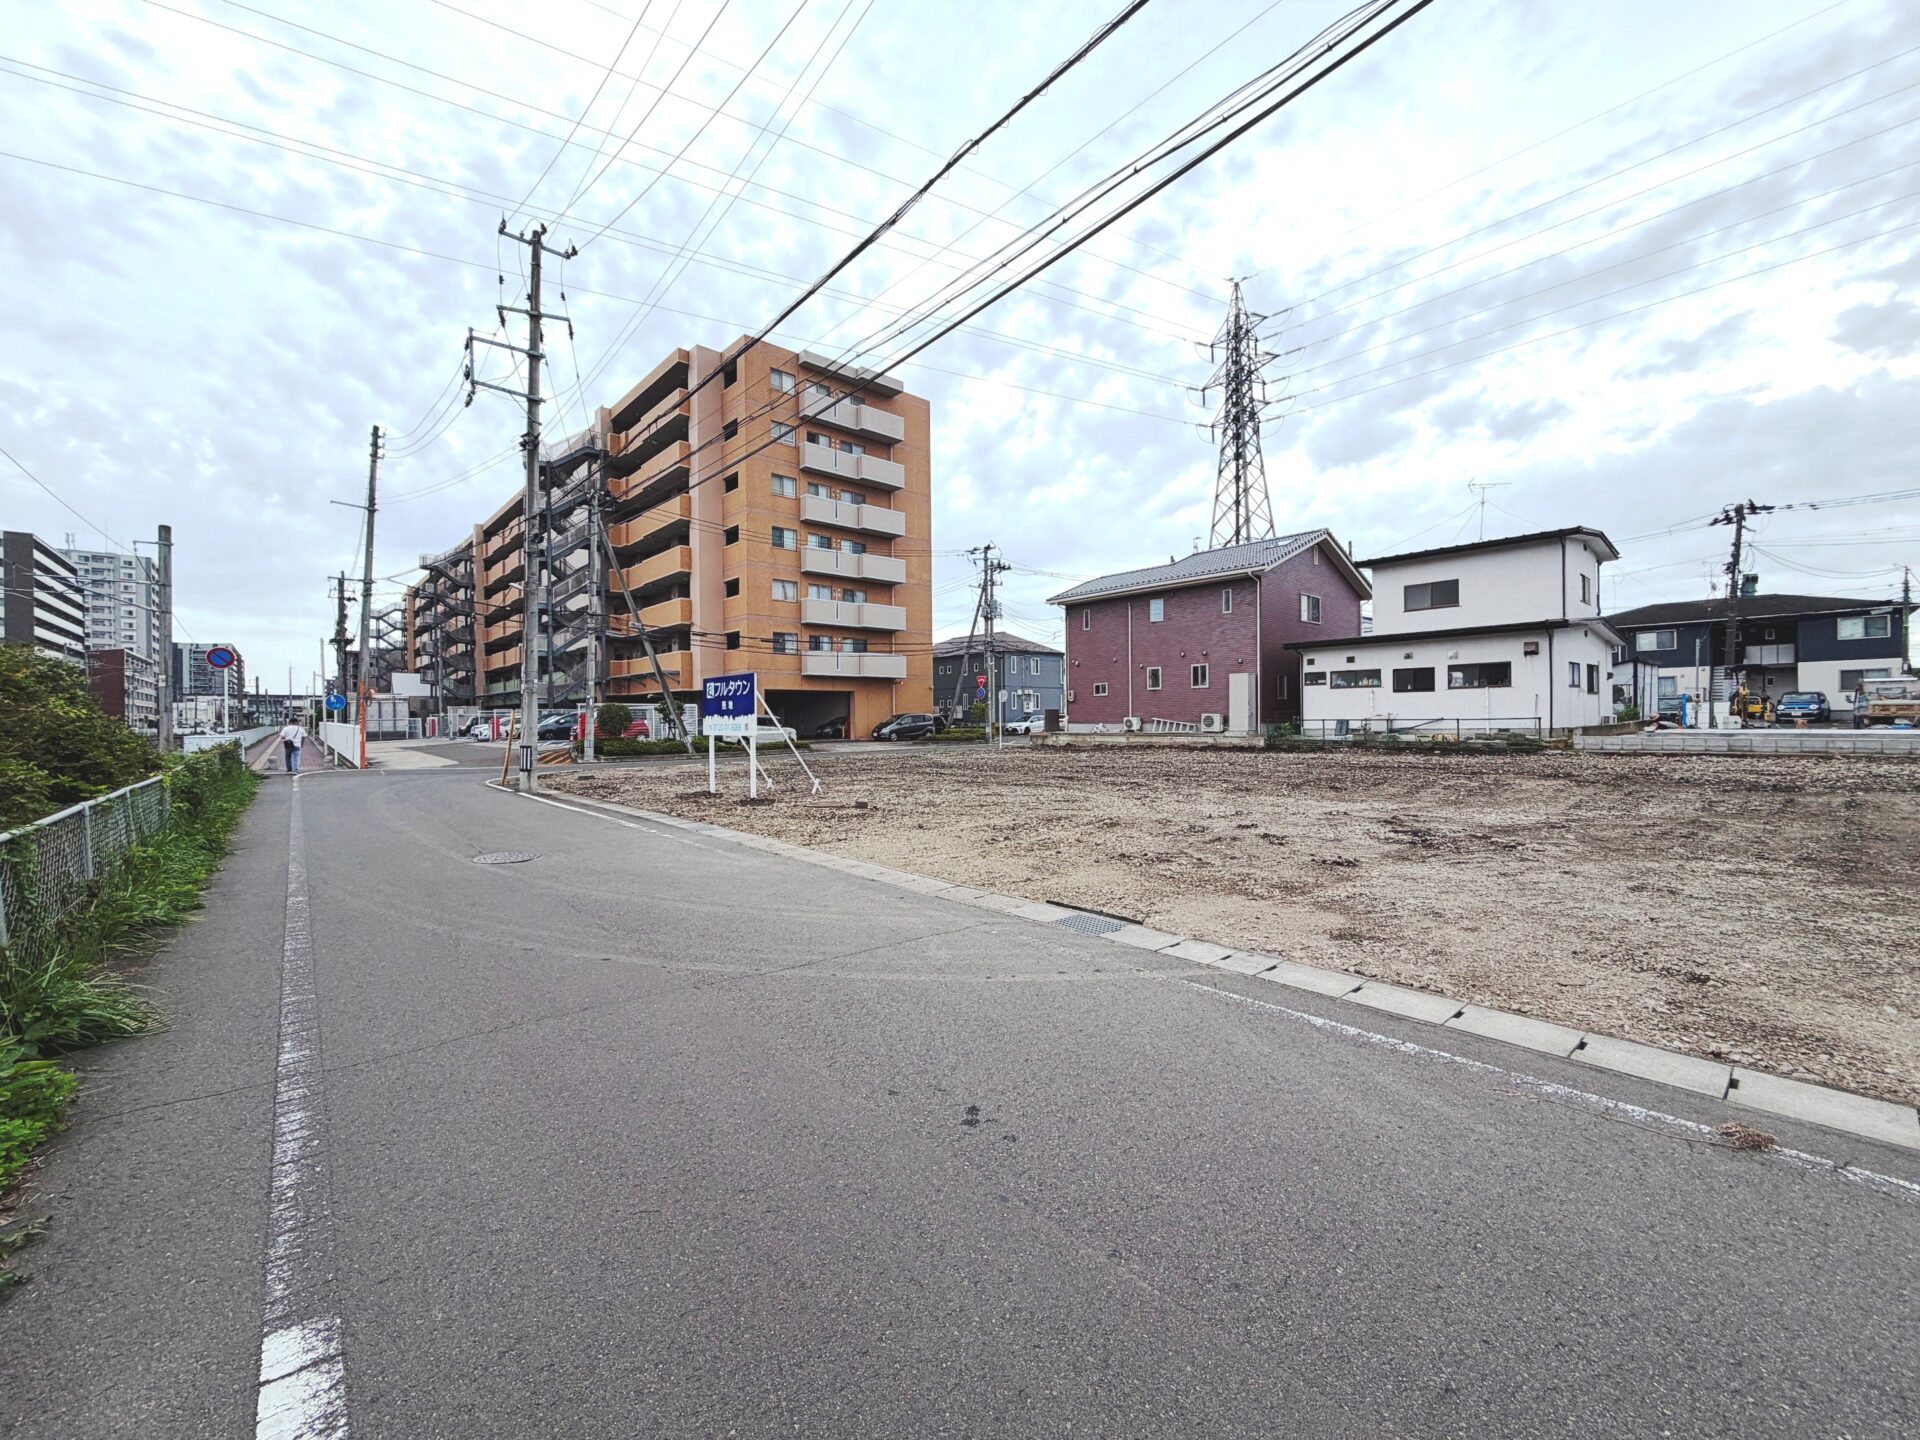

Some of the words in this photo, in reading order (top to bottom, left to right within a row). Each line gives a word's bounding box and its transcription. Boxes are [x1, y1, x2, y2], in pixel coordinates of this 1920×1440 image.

[714, 680, 751, 697] フルタウン
